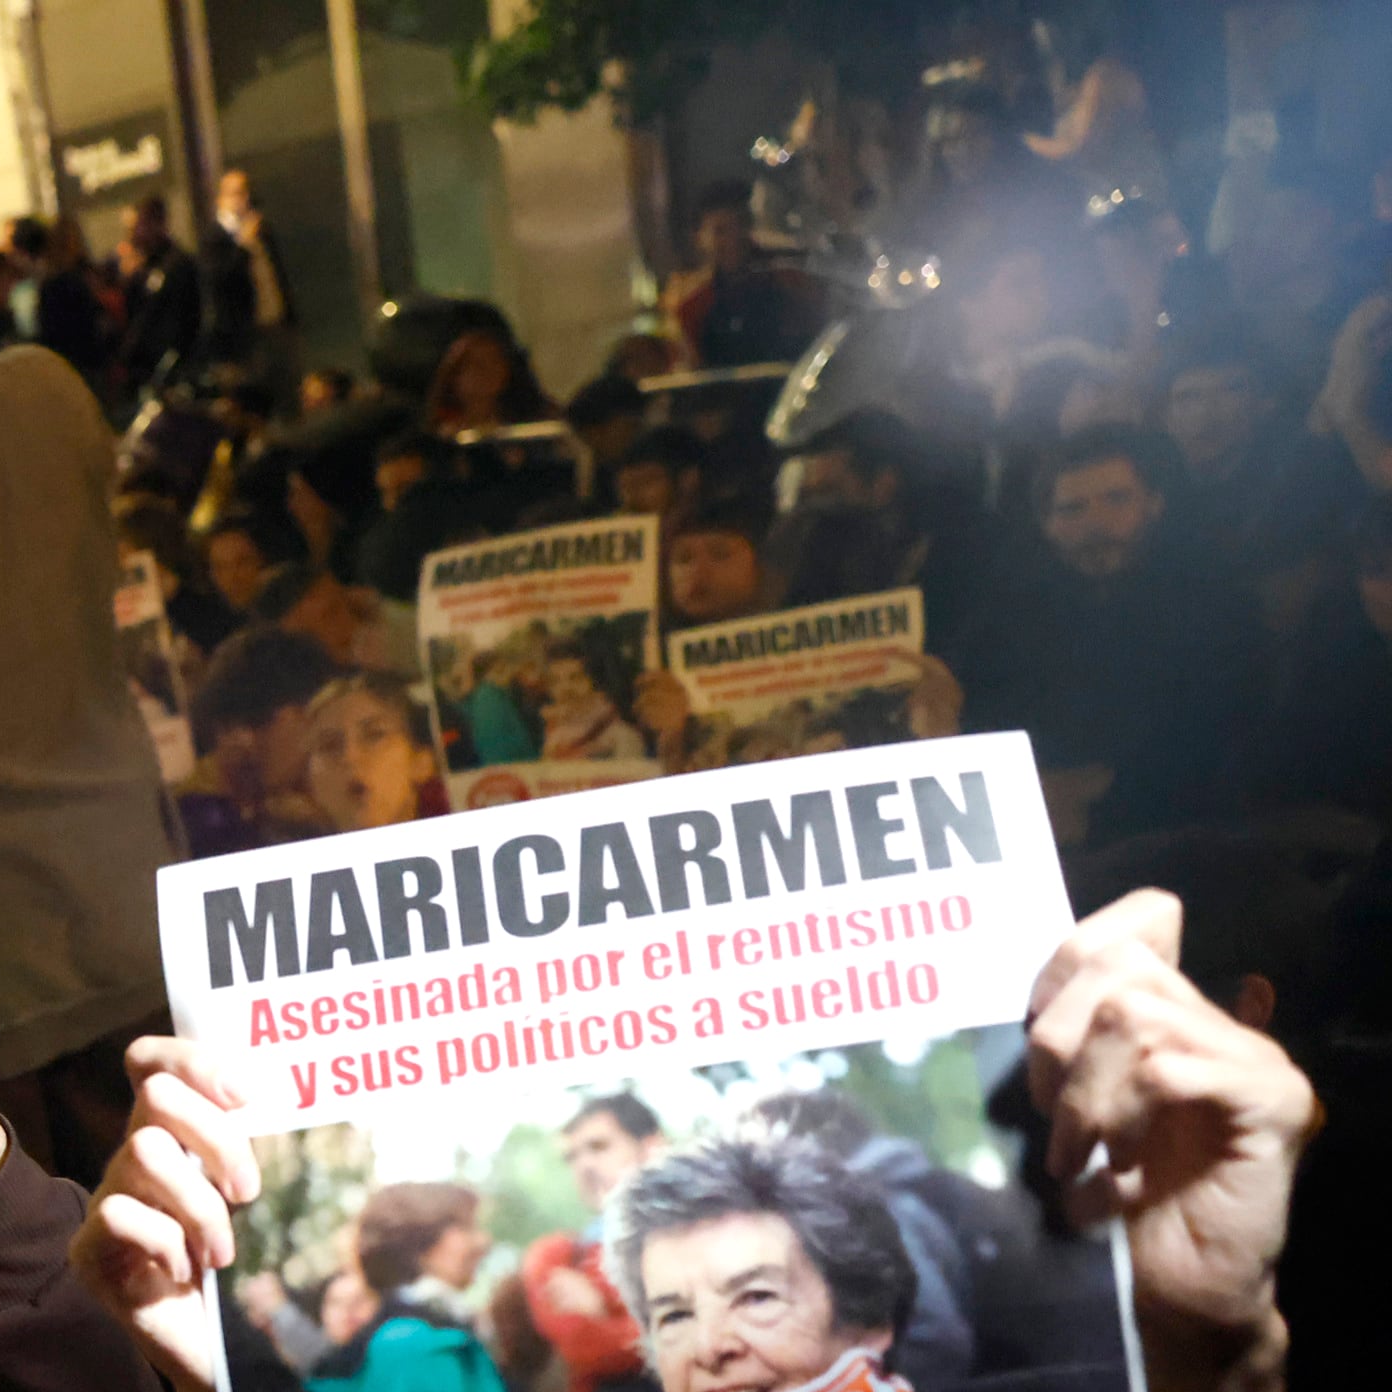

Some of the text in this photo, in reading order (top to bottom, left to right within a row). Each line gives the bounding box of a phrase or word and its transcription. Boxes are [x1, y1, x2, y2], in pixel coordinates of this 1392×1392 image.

[203, 770, 1003, 990] MARICARMEN
[247, 894, 974, 1048] Asesinada por el rentismo
[290, 957, 942, 1107] y sus políticos a sueldo
